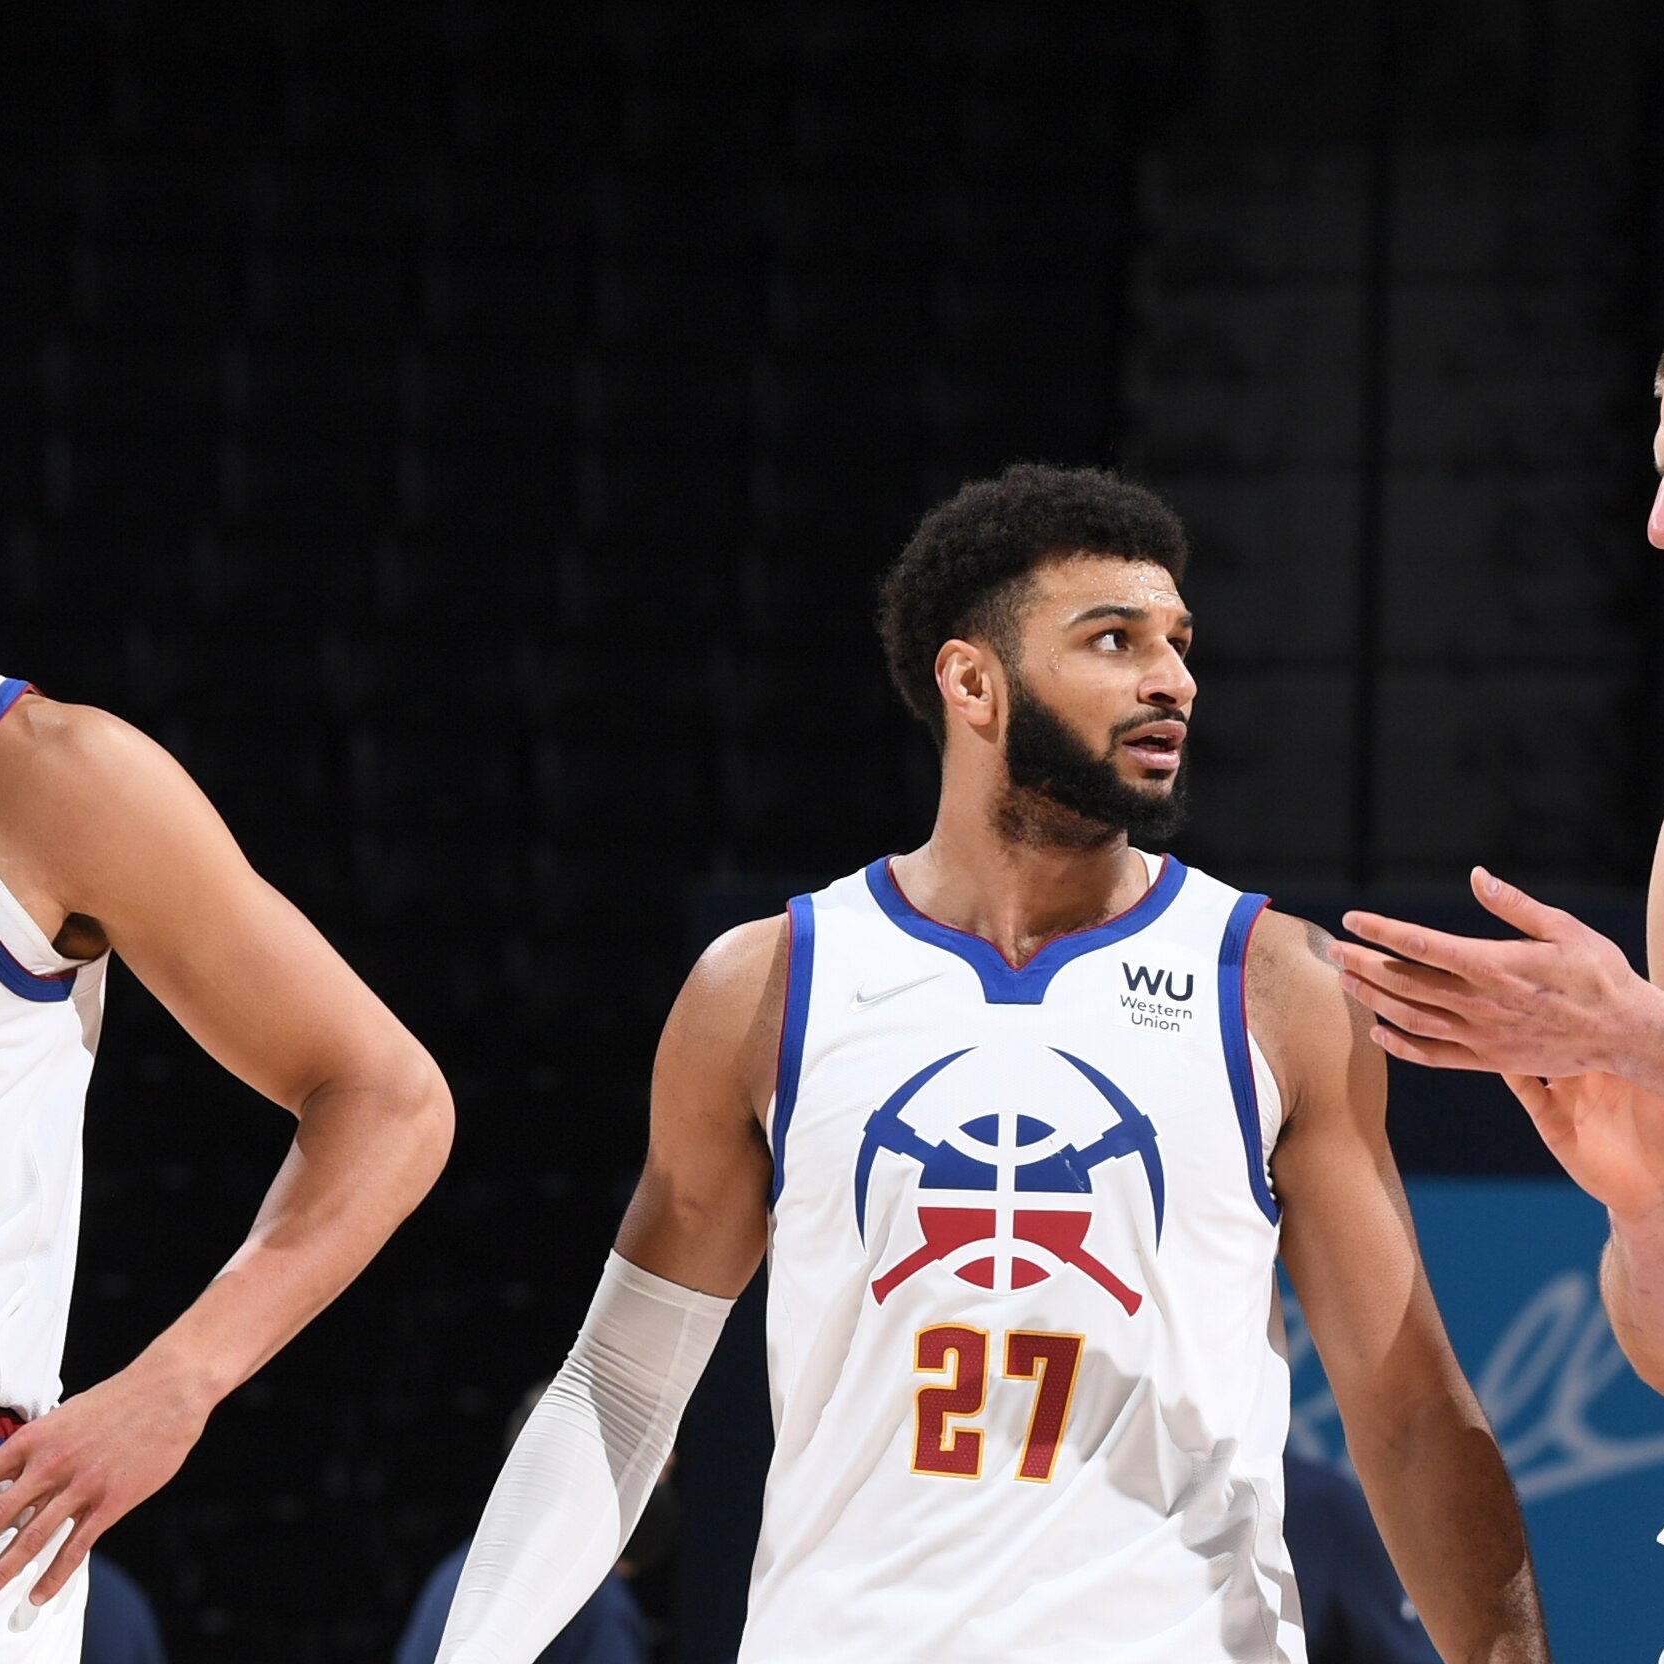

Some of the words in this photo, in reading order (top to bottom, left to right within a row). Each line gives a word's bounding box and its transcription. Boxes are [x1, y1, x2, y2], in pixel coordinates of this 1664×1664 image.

[1121, 961, 1194, 1002] WU
[1120, 994, 1192, 1020] Western
[1131, 1012, 1180, 1032] Union
[910, 1322, 1086, 1484] 27
